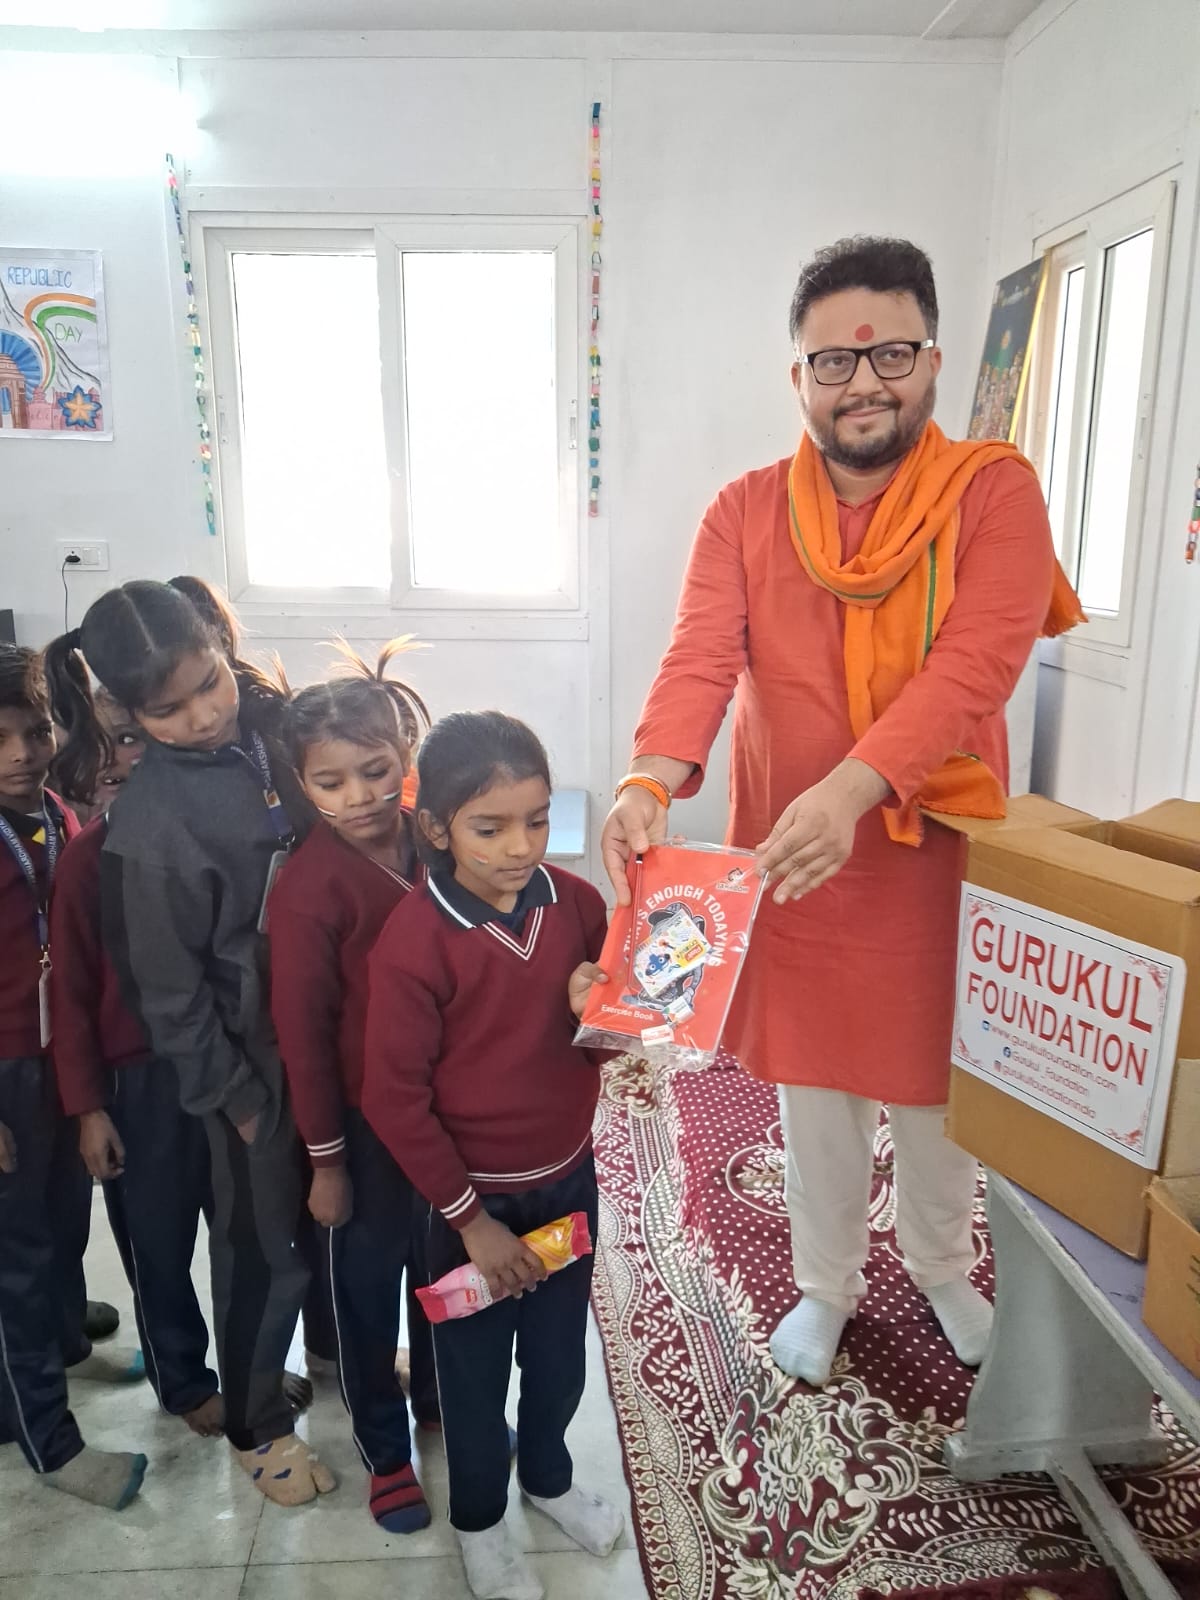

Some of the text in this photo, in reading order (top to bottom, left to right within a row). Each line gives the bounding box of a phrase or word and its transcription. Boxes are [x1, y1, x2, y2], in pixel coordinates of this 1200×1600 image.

[8, 266, 73, 289] REPUBLIC
[54, 322, 83, 343] DAY
[646, 884, 704, 910] ENOUGH
[703, 894, 728, 967] TODAYING
[972, 917, 1152, 1034] GURUKUL
[601, 1005, 655, 1022] Exercise Book
[967, 972, 1149, 1086] FOUNDATION
[1024, 1545, 1070, 1561] PARI
